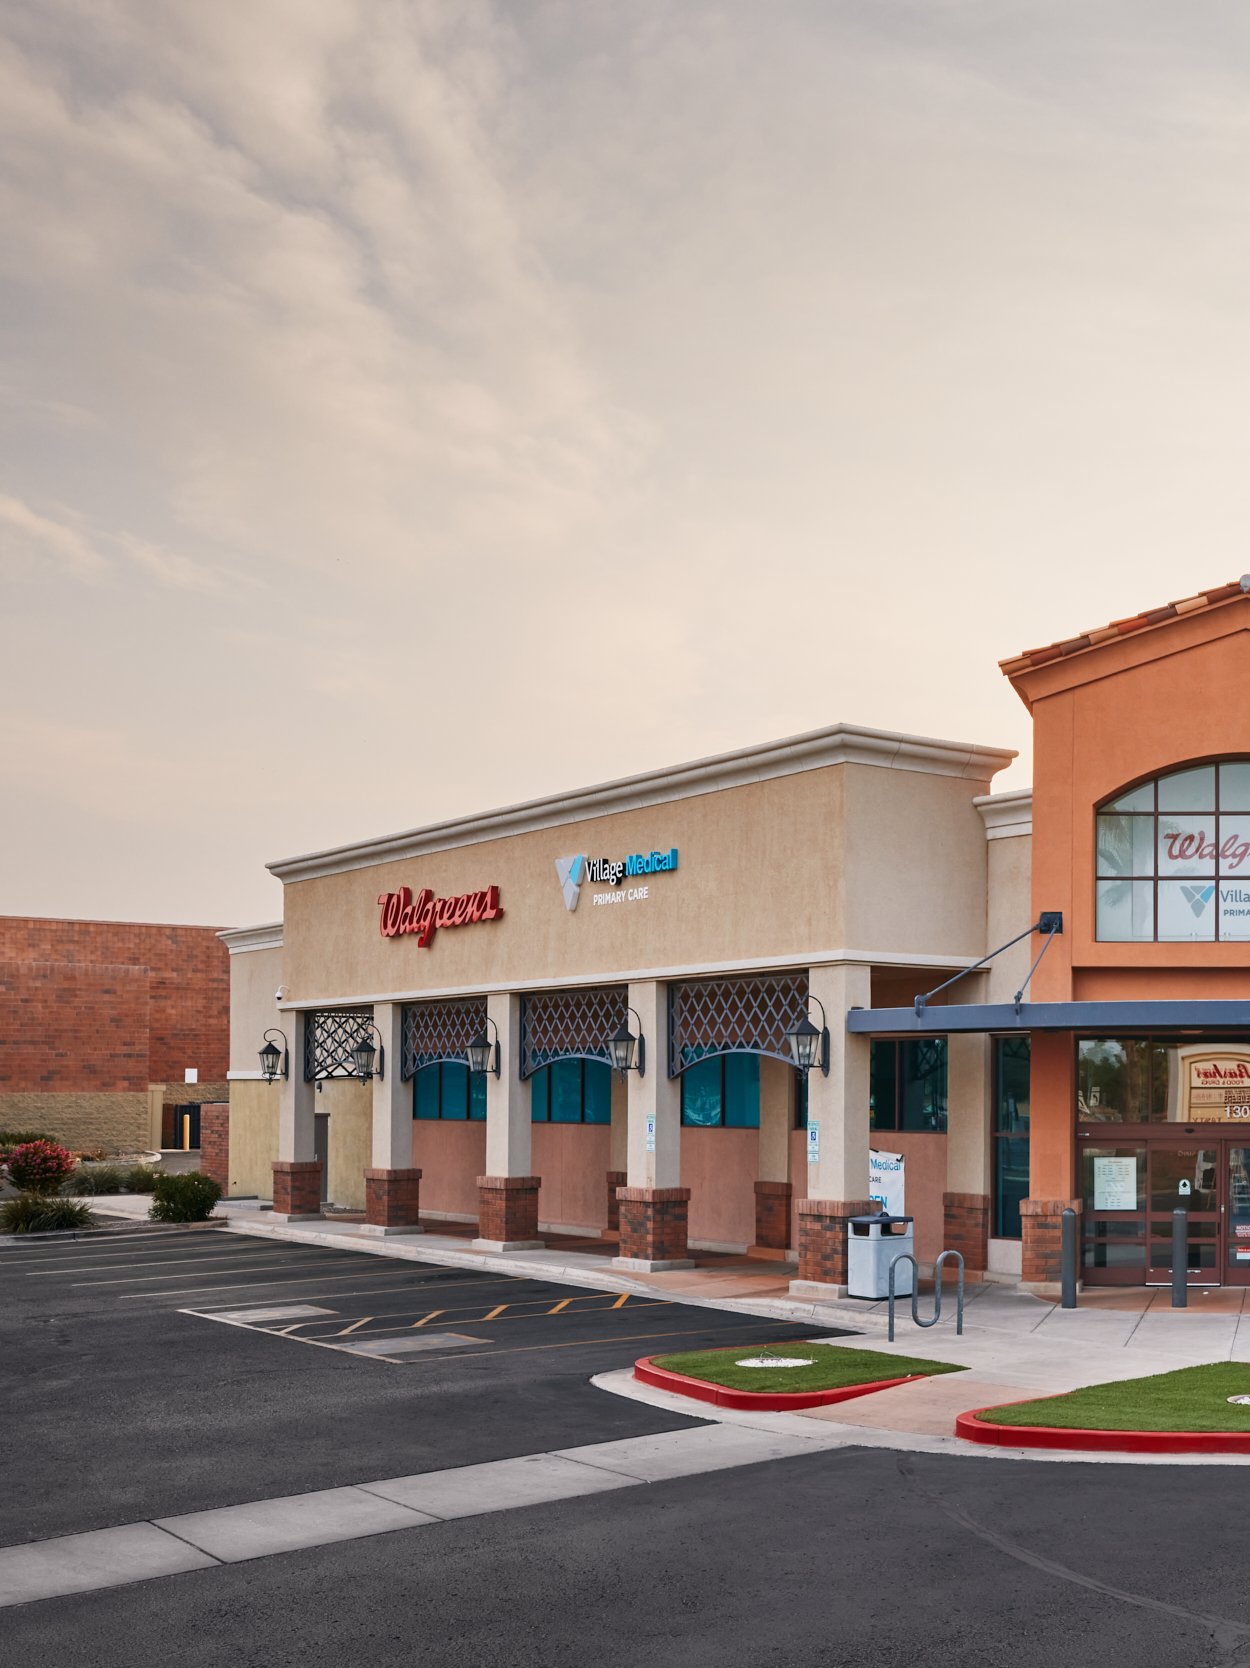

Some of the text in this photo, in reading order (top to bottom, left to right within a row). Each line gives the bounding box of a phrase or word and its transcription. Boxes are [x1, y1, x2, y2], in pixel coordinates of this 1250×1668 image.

[585, 848, 678, 885] Village Medical
[593, 886, 649, 906] PRIMARY CARE
[378, 885, 503, 949] Walgreens
[870, 1158, 901, 1171] Medical
